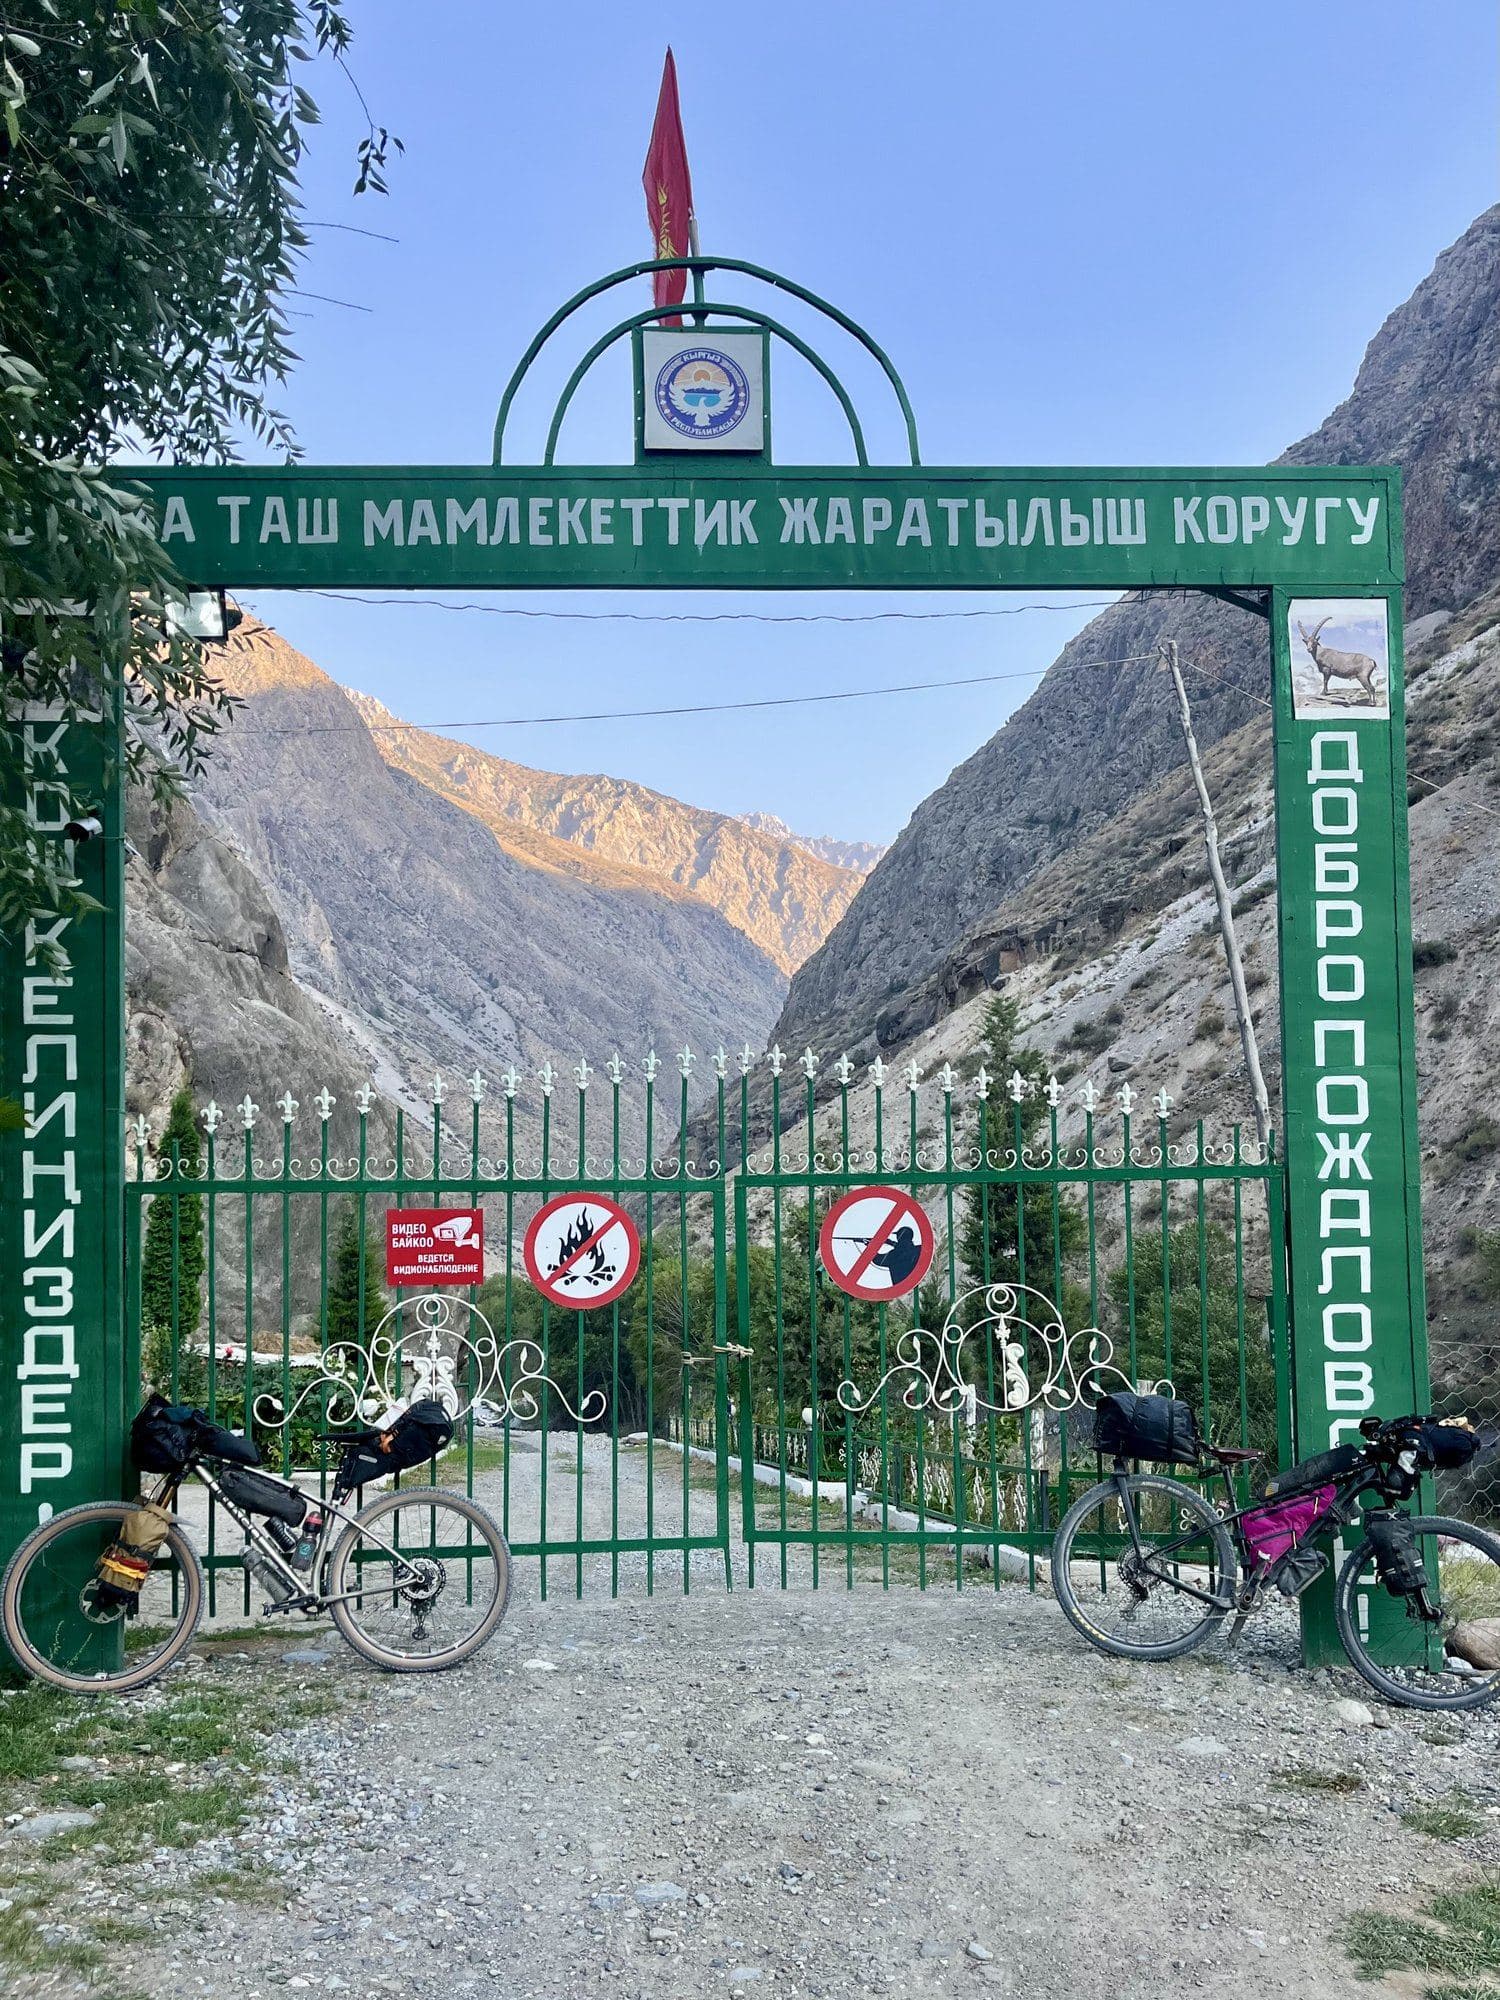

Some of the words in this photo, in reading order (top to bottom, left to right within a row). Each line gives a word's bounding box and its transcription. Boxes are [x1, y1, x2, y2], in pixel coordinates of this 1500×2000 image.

[217, 496, 338, 544] ТАШ
[363, 497, 760, 547] МАМЛЕКЕТТИК
[779, 496, 1147, 547] ЖАРАТЫЛЫШ
[1173, 495, 1380, 546] КОРУГУ
[1307, 730, 1364, 1003] ДОБРО
[391, 1223, 427, 1235] ВИДЕО
[392, 1234, 434, 1248] БАЙКОО
[417, 1254, 454, 1263] ВЕДЕТСЯ
